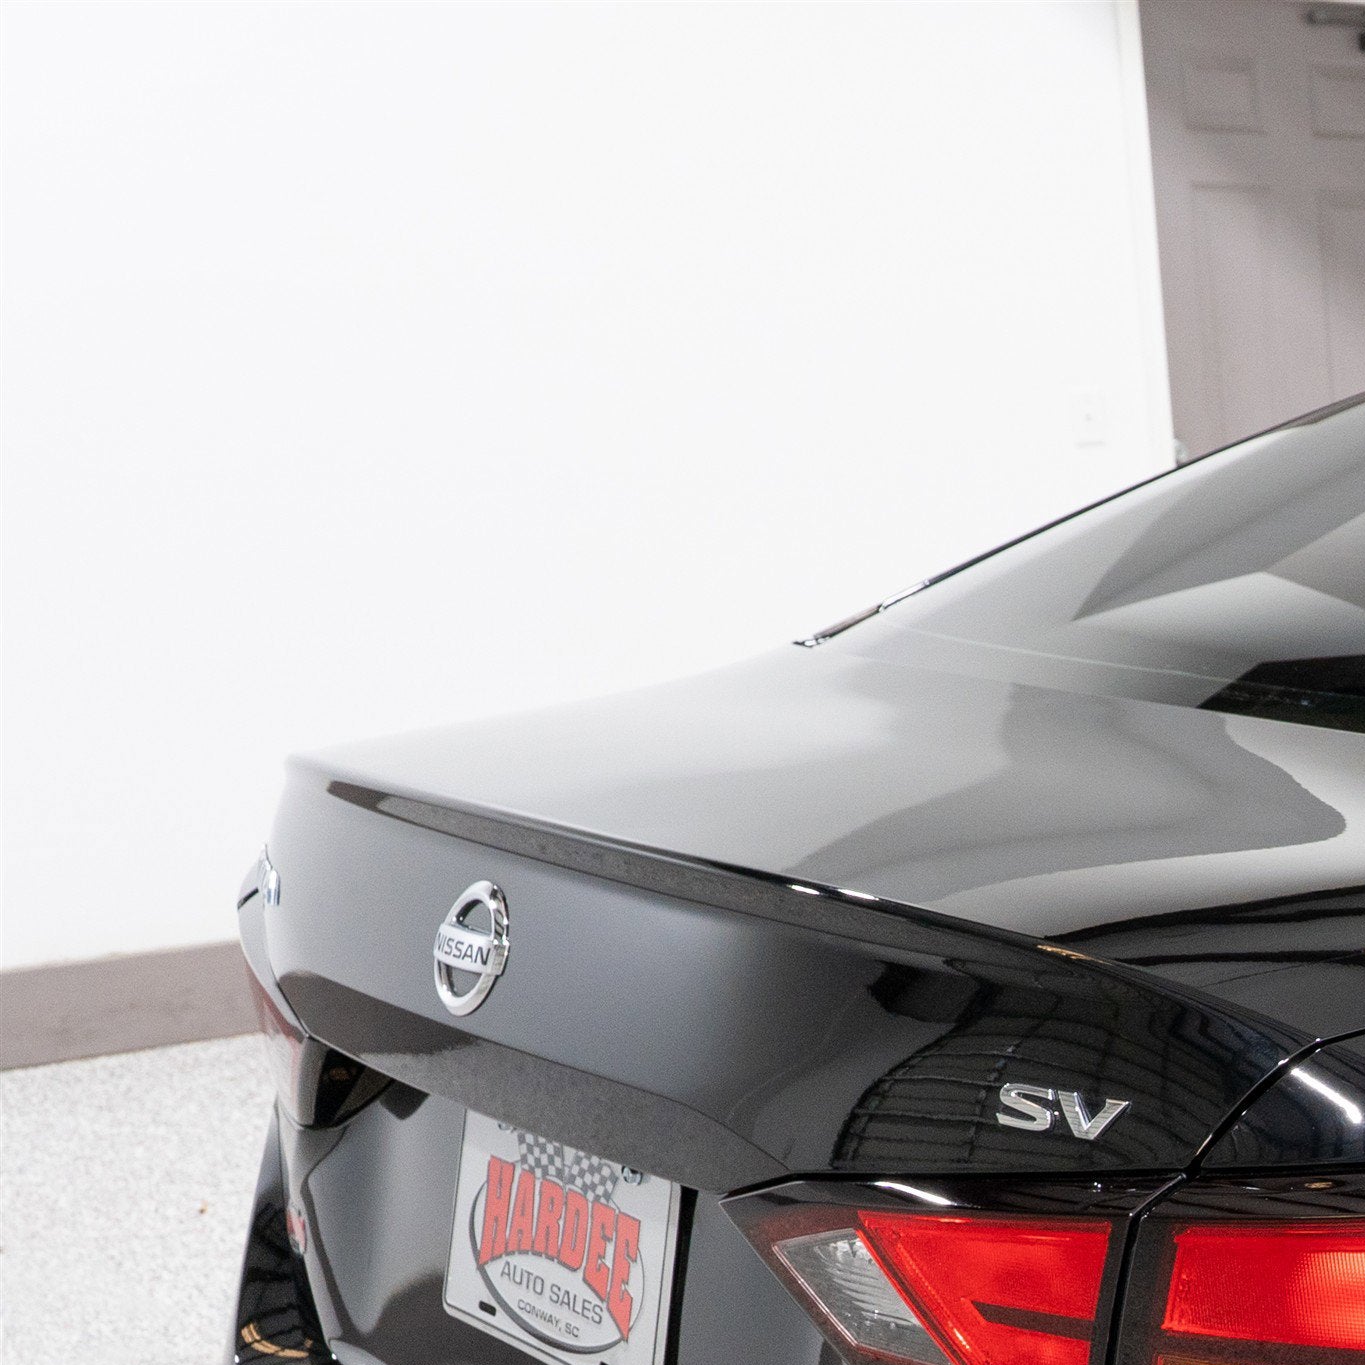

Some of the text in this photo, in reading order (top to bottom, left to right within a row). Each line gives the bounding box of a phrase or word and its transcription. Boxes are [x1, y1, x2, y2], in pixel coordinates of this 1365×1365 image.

[437, 931, 492, 966] NISSAN
[996, 1083, 1132, 1140] SV
[478, 1155, 641, 1342] HARDEE
[500, 1260, 604, 1325] AUTO SALES
[517, 1298, 580, 1338] CONWAY, SC
